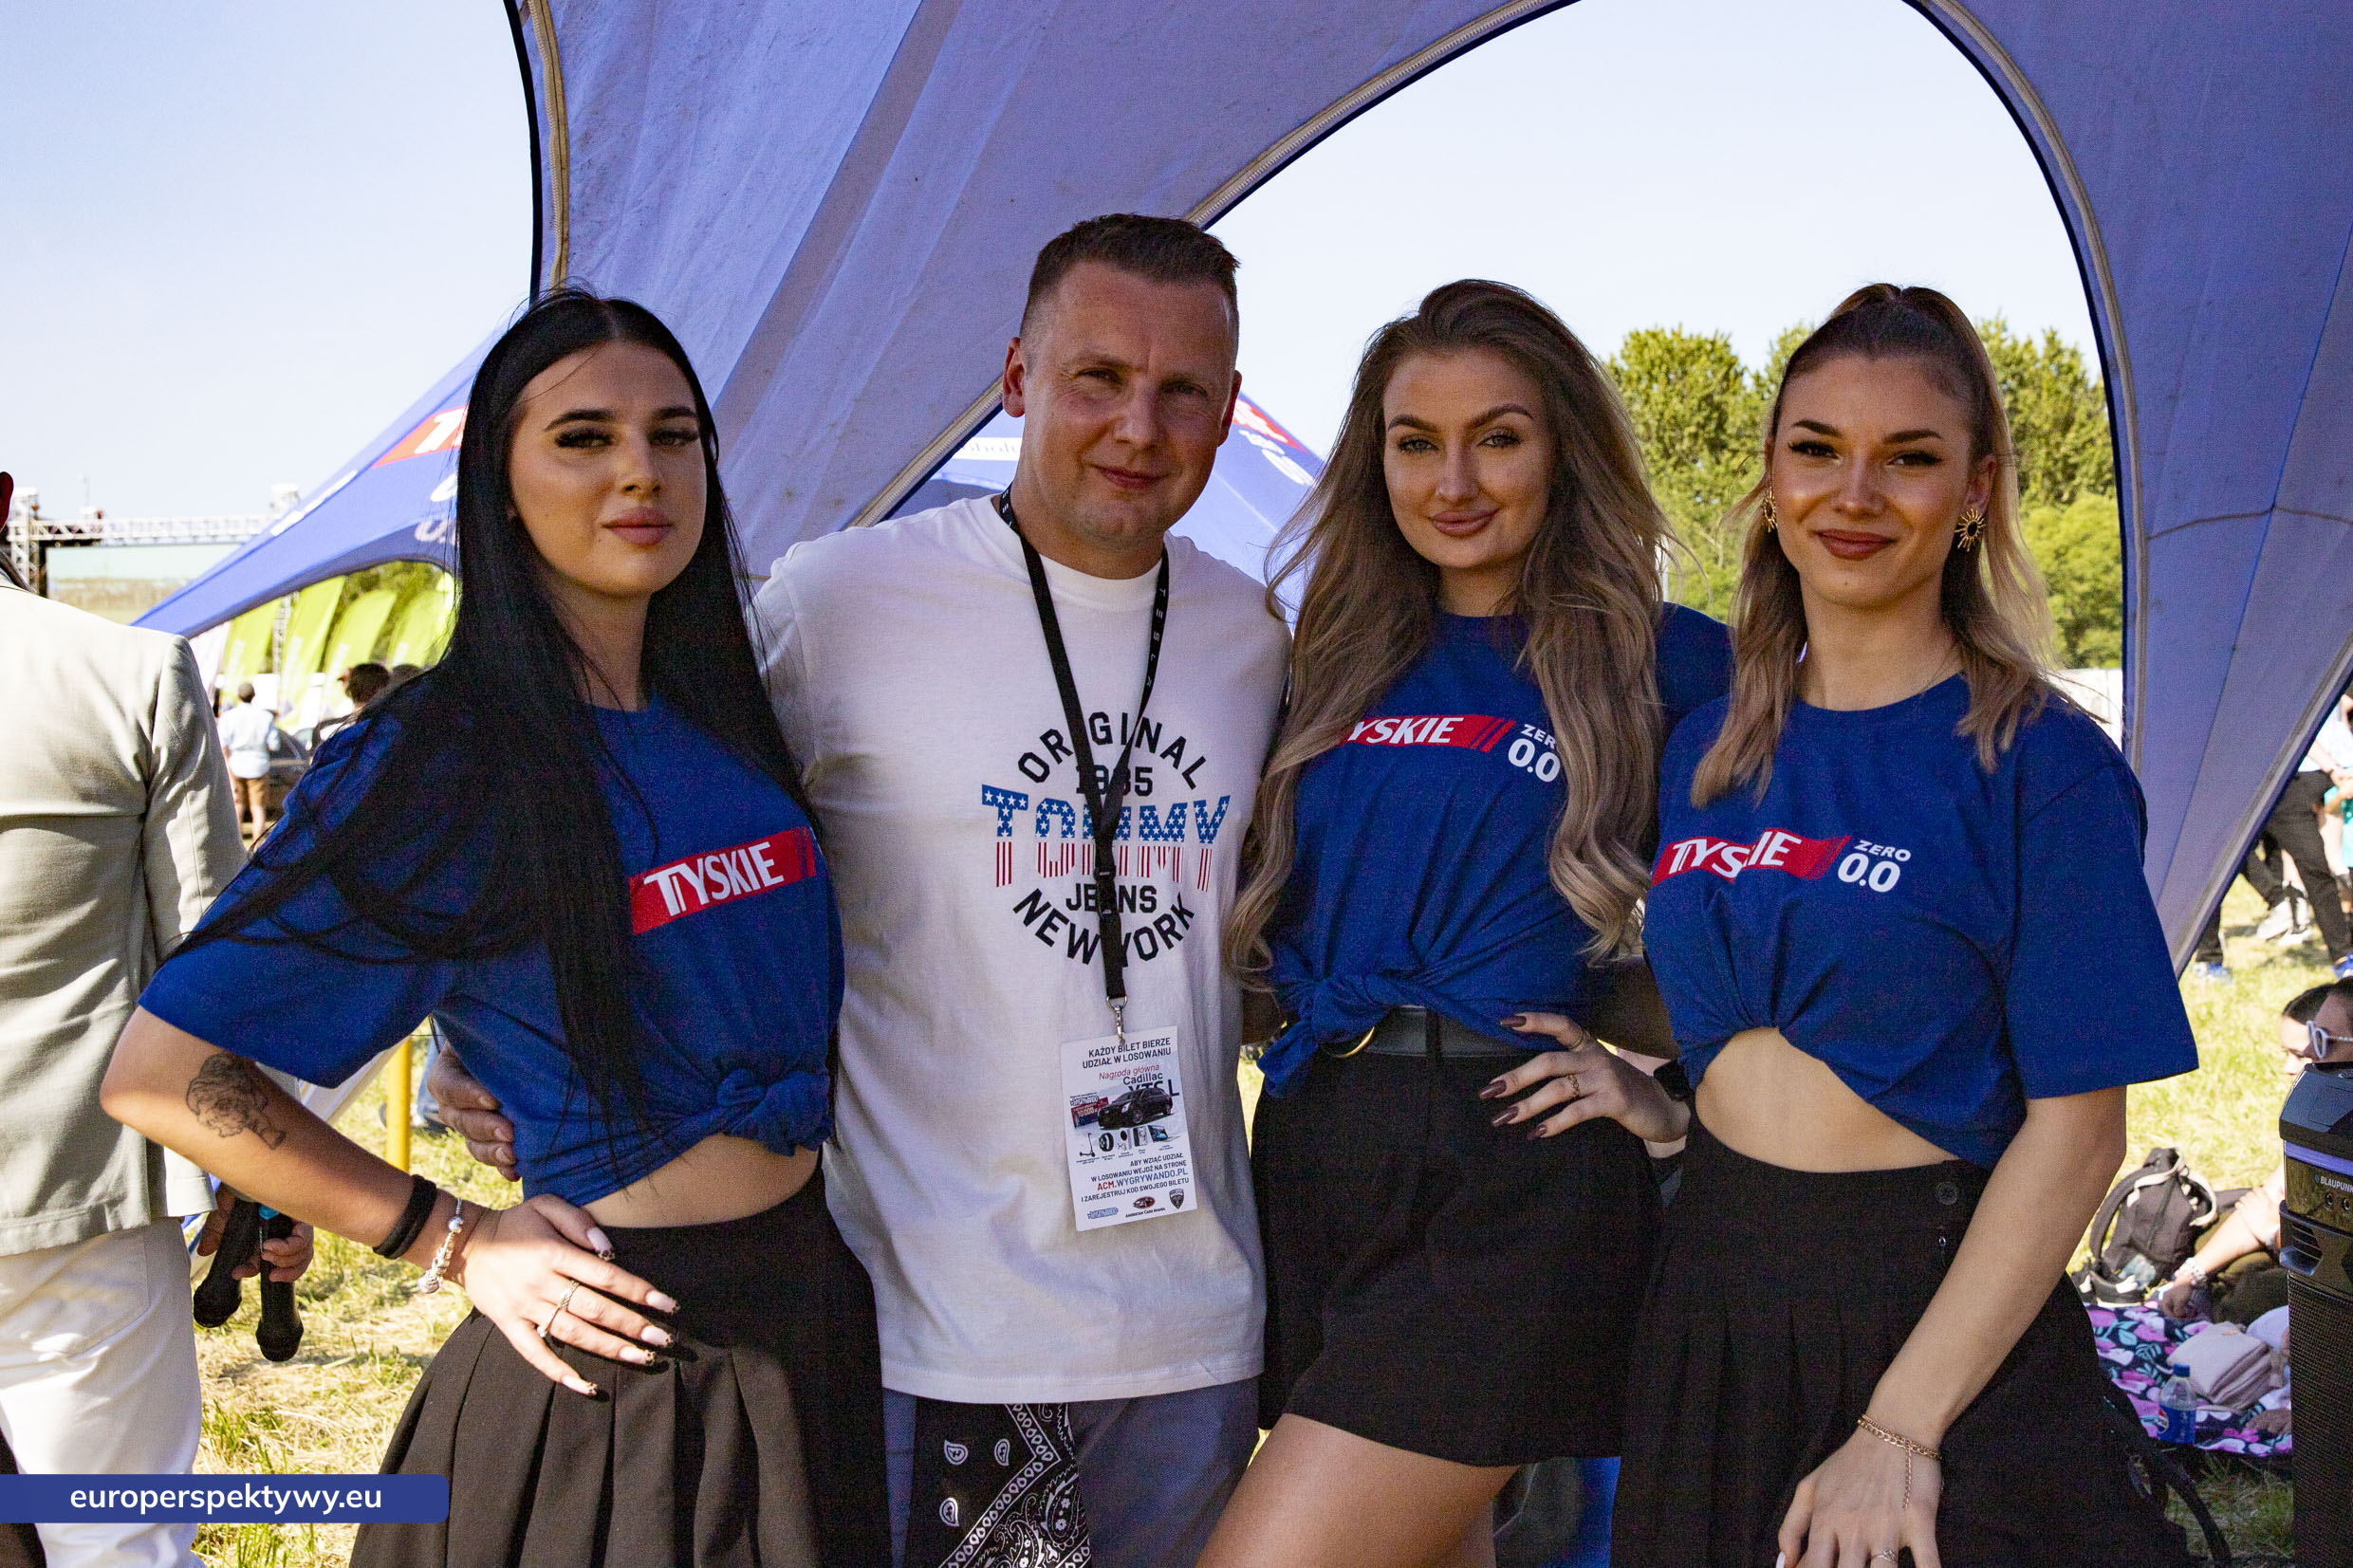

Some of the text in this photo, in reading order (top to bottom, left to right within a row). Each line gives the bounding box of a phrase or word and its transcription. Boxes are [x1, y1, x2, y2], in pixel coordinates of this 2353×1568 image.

[1347, 717, 1464, 745] YSKIE
[1520, 723, 1557, 749] ZER
[1017, 711, 1207, 790] ORGINAL
[1508, 738, 1561, 783] 0.0
[1668, 831, 1802, 878] TYSIE
[1853, 839, 1912, 862] ZERO
[643, 841, 785, 917] TYSKIE
[1837, 853, 1901, 893] 0.0
[1065, 883, 1158, 913] JENS
[1012, 888, 1102, 966] NEW
[1083, 1047, 1172, 1069] UDZIAŁ W LOSOWANIU
[1088, 1037, 1171, 1058] KAŻDY BILET BIERZE
[1099, 1063, 1159, 1080] Nagroda główna
[1122, 1072, 1163, 1085] Cadillac
[1084, 1190, 1126, 1203] ZAREJESTRUJ
[1139, 1182, 1168, 1192] SWOJEGO
[1168, 1177, 1190, 1187] BILETU
[1098, 1171, 1133, 1182] LOSOWANIU
